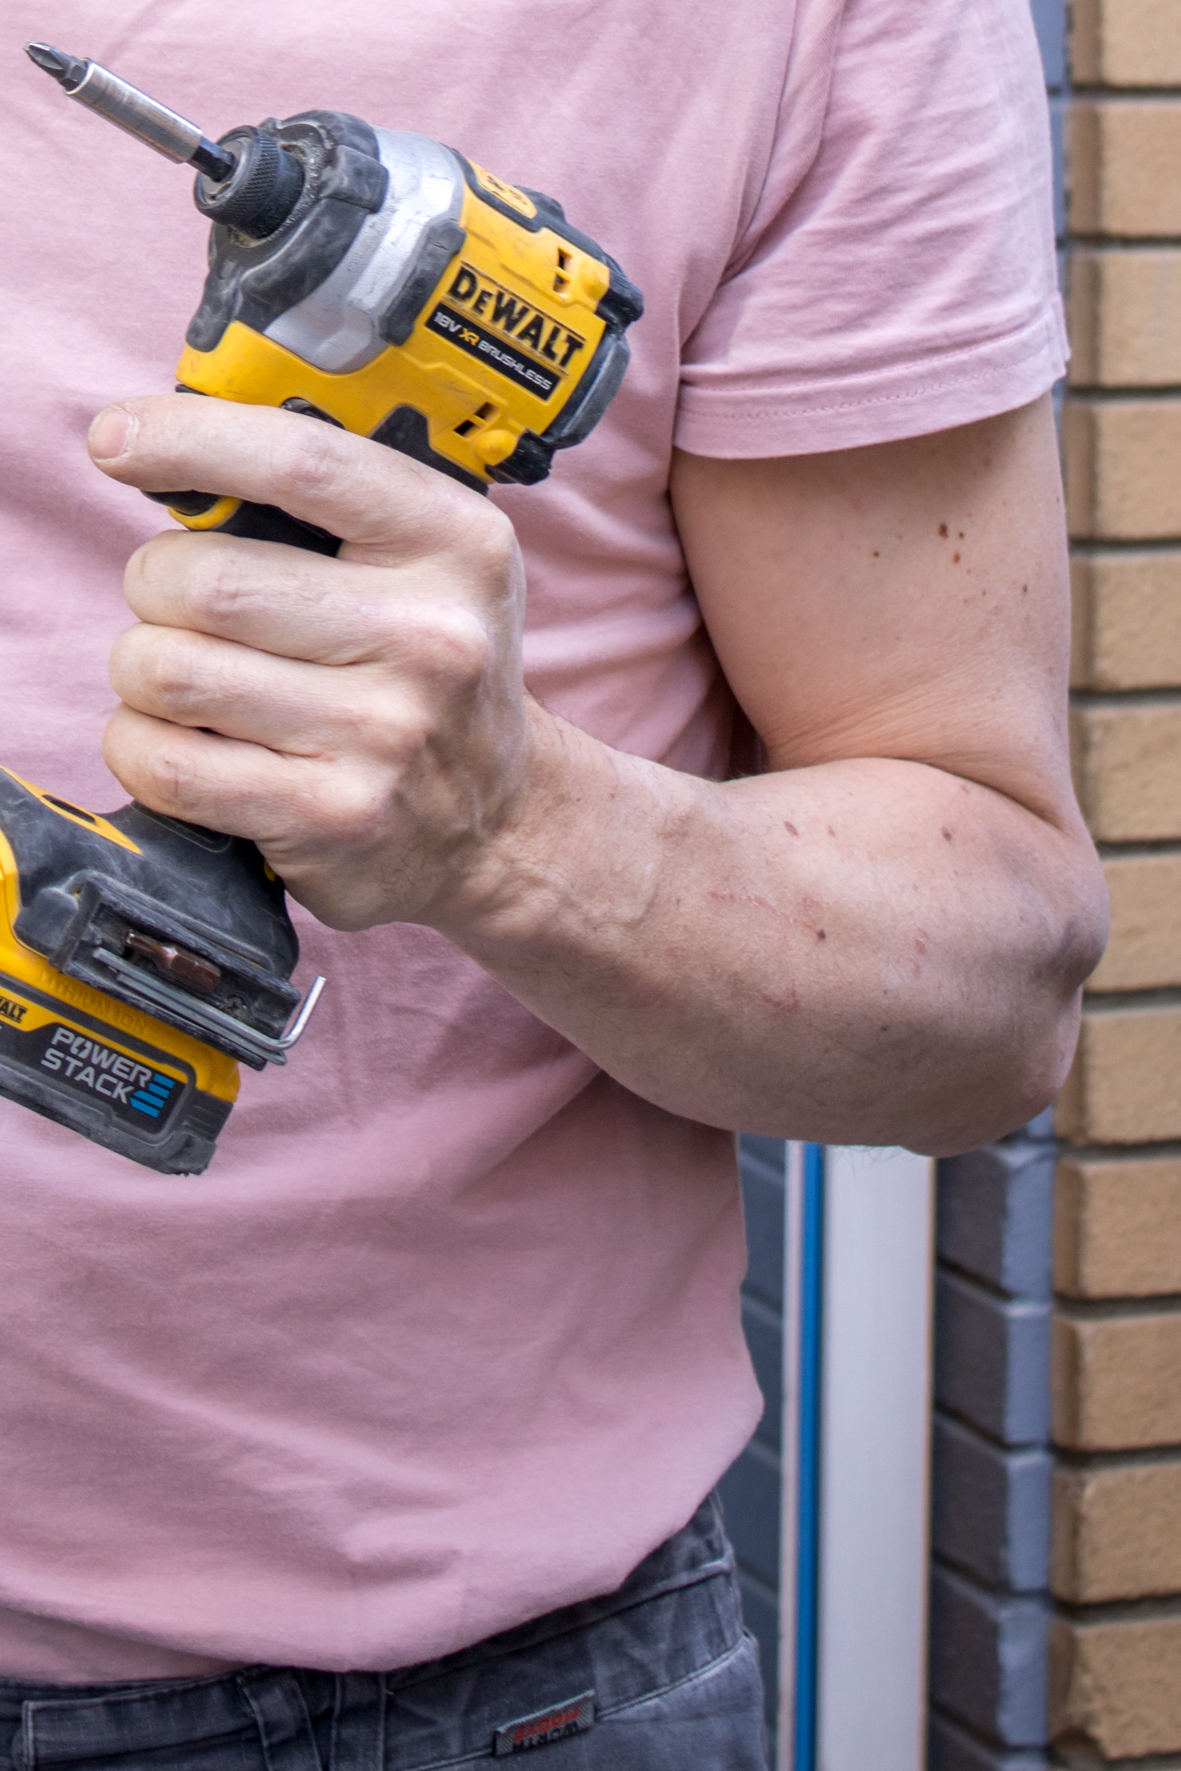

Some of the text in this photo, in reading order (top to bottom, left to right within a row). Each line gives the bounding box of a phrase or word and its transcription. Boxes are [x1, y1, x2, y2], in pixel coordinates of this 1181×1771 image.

[433, 311, 553, 391] 18V XR BRUSHLESS
[41, 1047, 135, 1105] STACK
[50, 1026, 153, 1088] POWER
